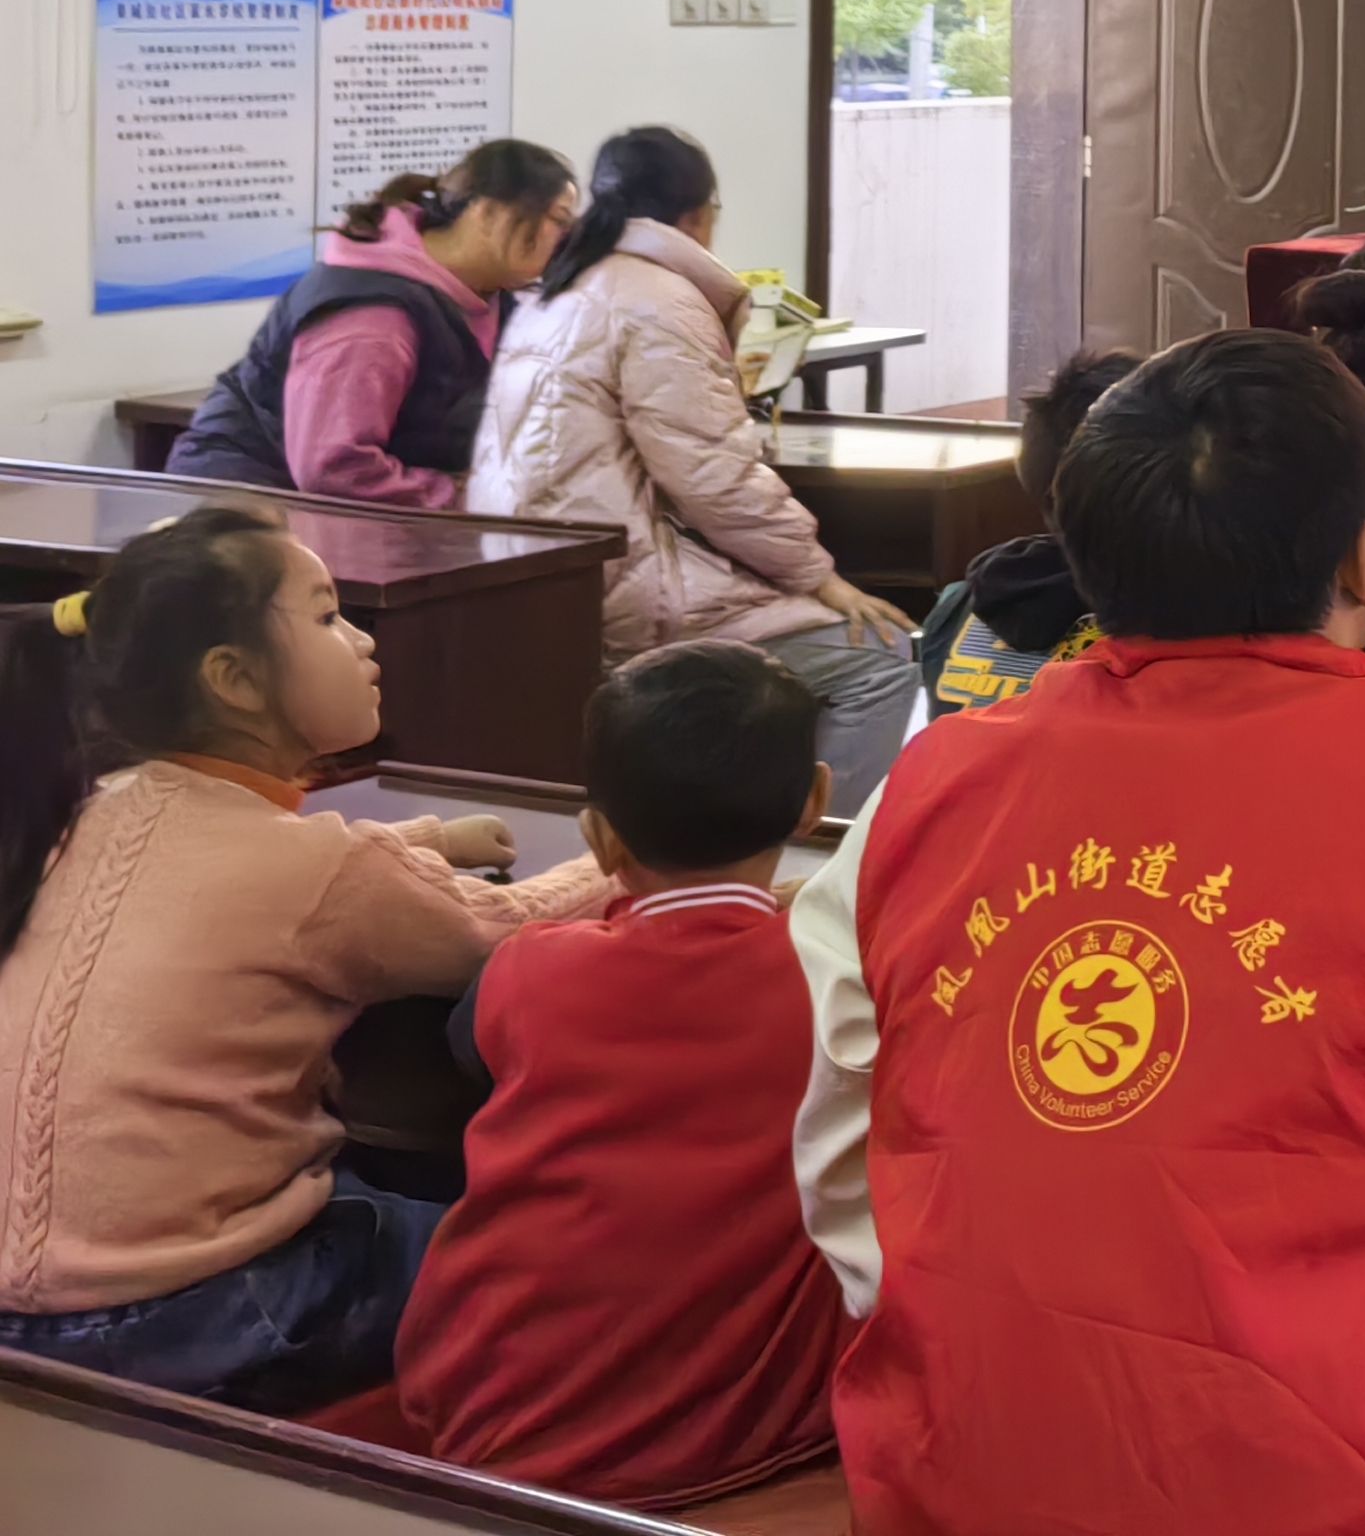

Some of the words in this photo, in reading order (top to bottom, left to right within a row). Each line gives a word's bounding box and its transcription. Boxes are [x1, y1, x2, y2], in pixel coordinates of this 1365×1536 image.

[1016, 1044, 1040, 1094] China
[1039, 1086, 1115, 1119] Volunteer
[1117, 1051, 1172, 1107] Service
